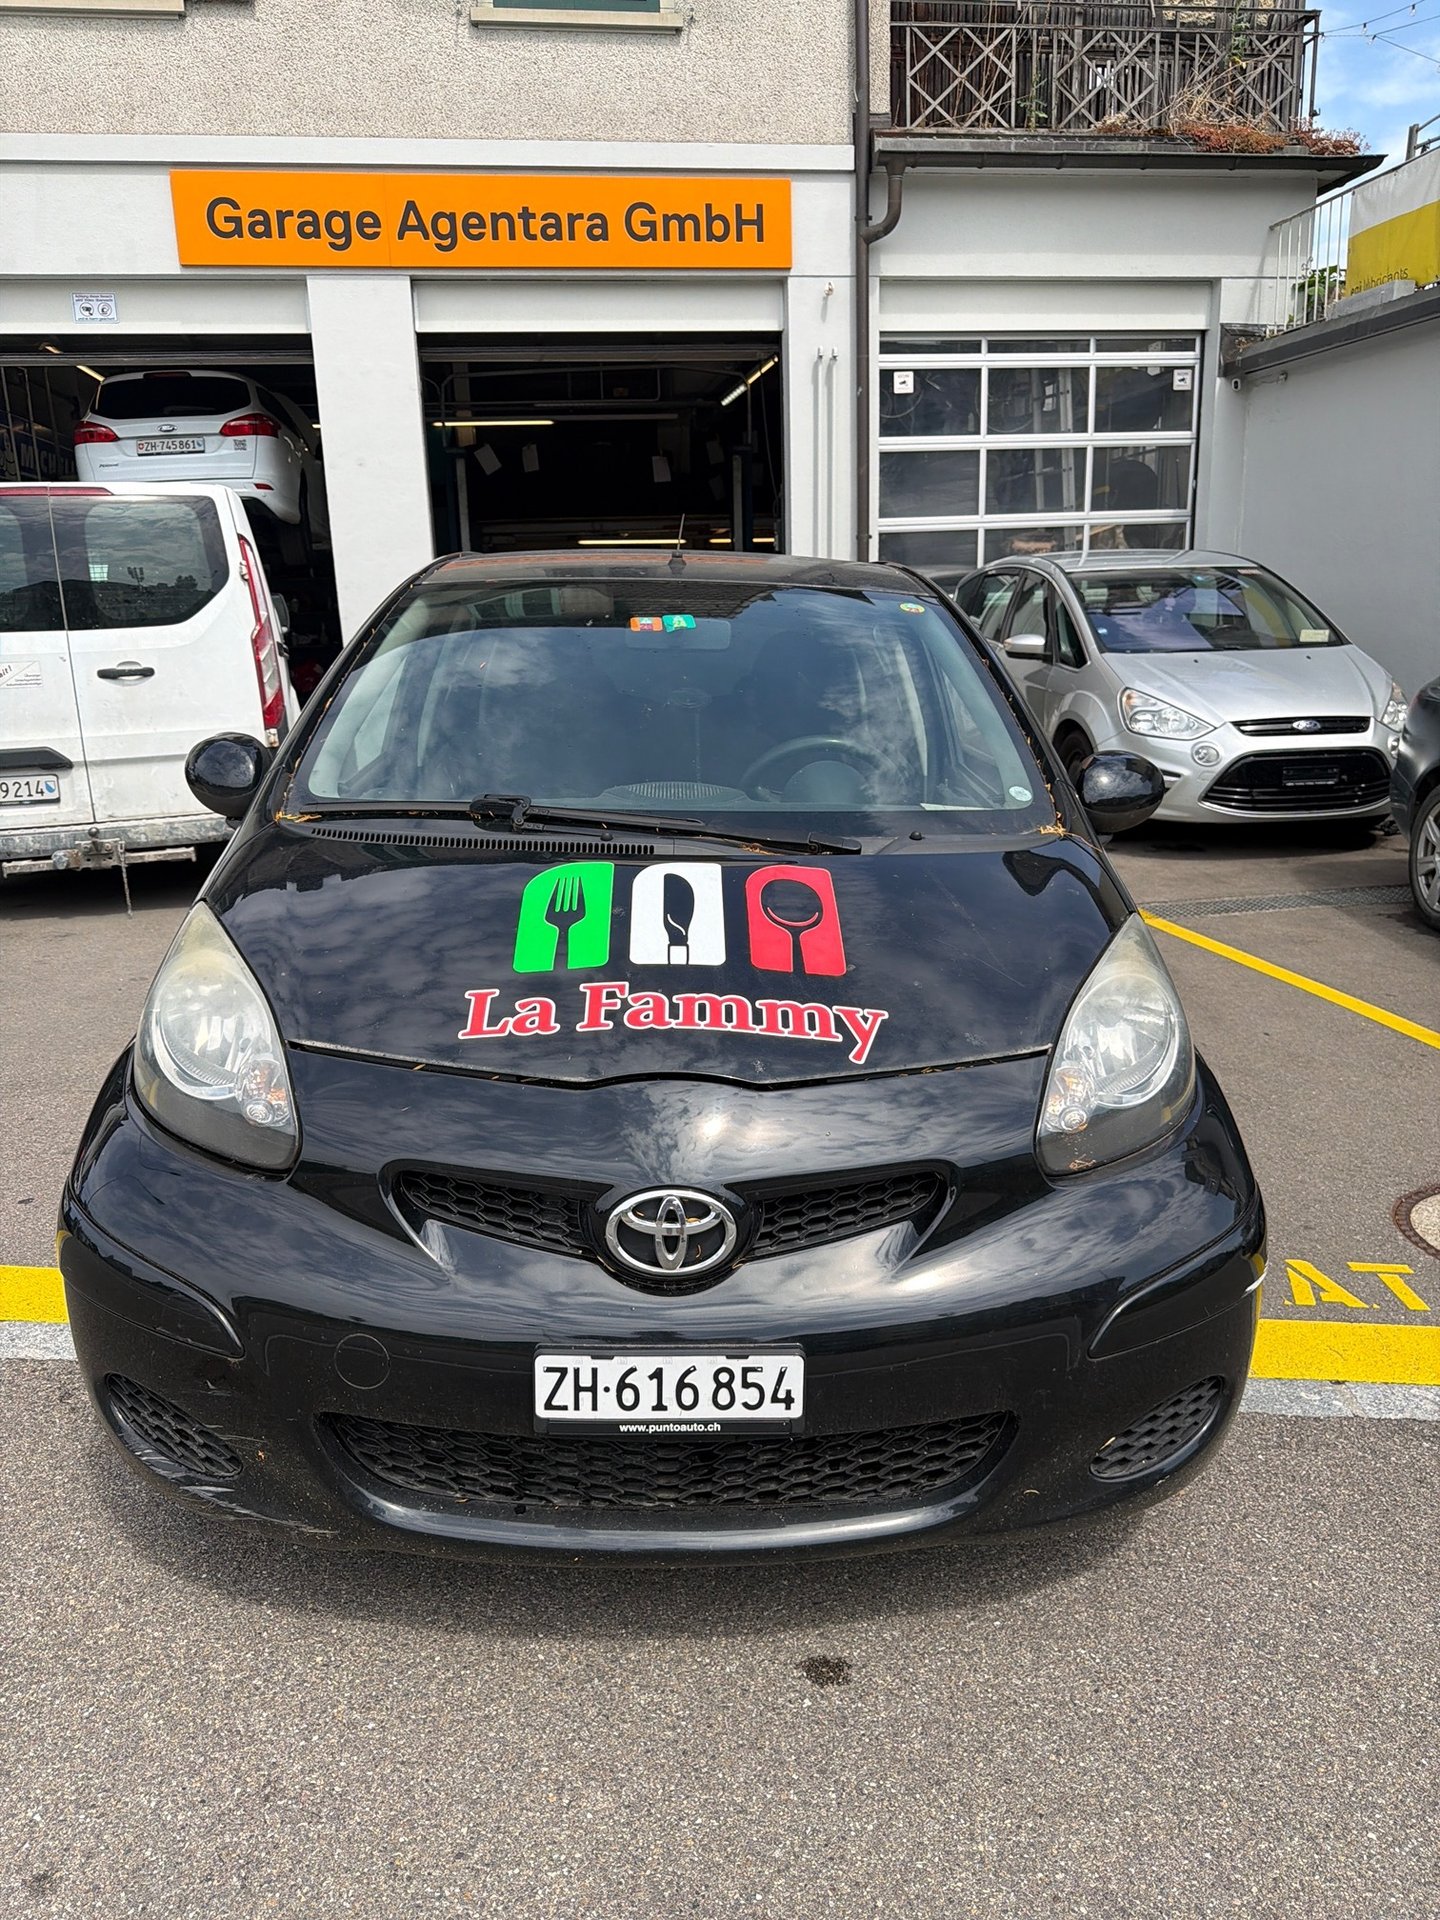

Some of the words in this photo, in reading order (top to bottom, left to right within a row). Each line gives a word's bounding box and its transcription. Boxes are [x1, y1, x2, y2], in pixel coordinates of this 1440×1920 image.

[206, 196, 382, 251] Garage
[397, 200, 609, 252] Agentara
[624, 201, 765, 243] GmbH
[458, 988, 560, 1039] La
[575, 981, 889, 1065] Fammy
[618, 1422, 722, 1434] www.puntoauto.ch
